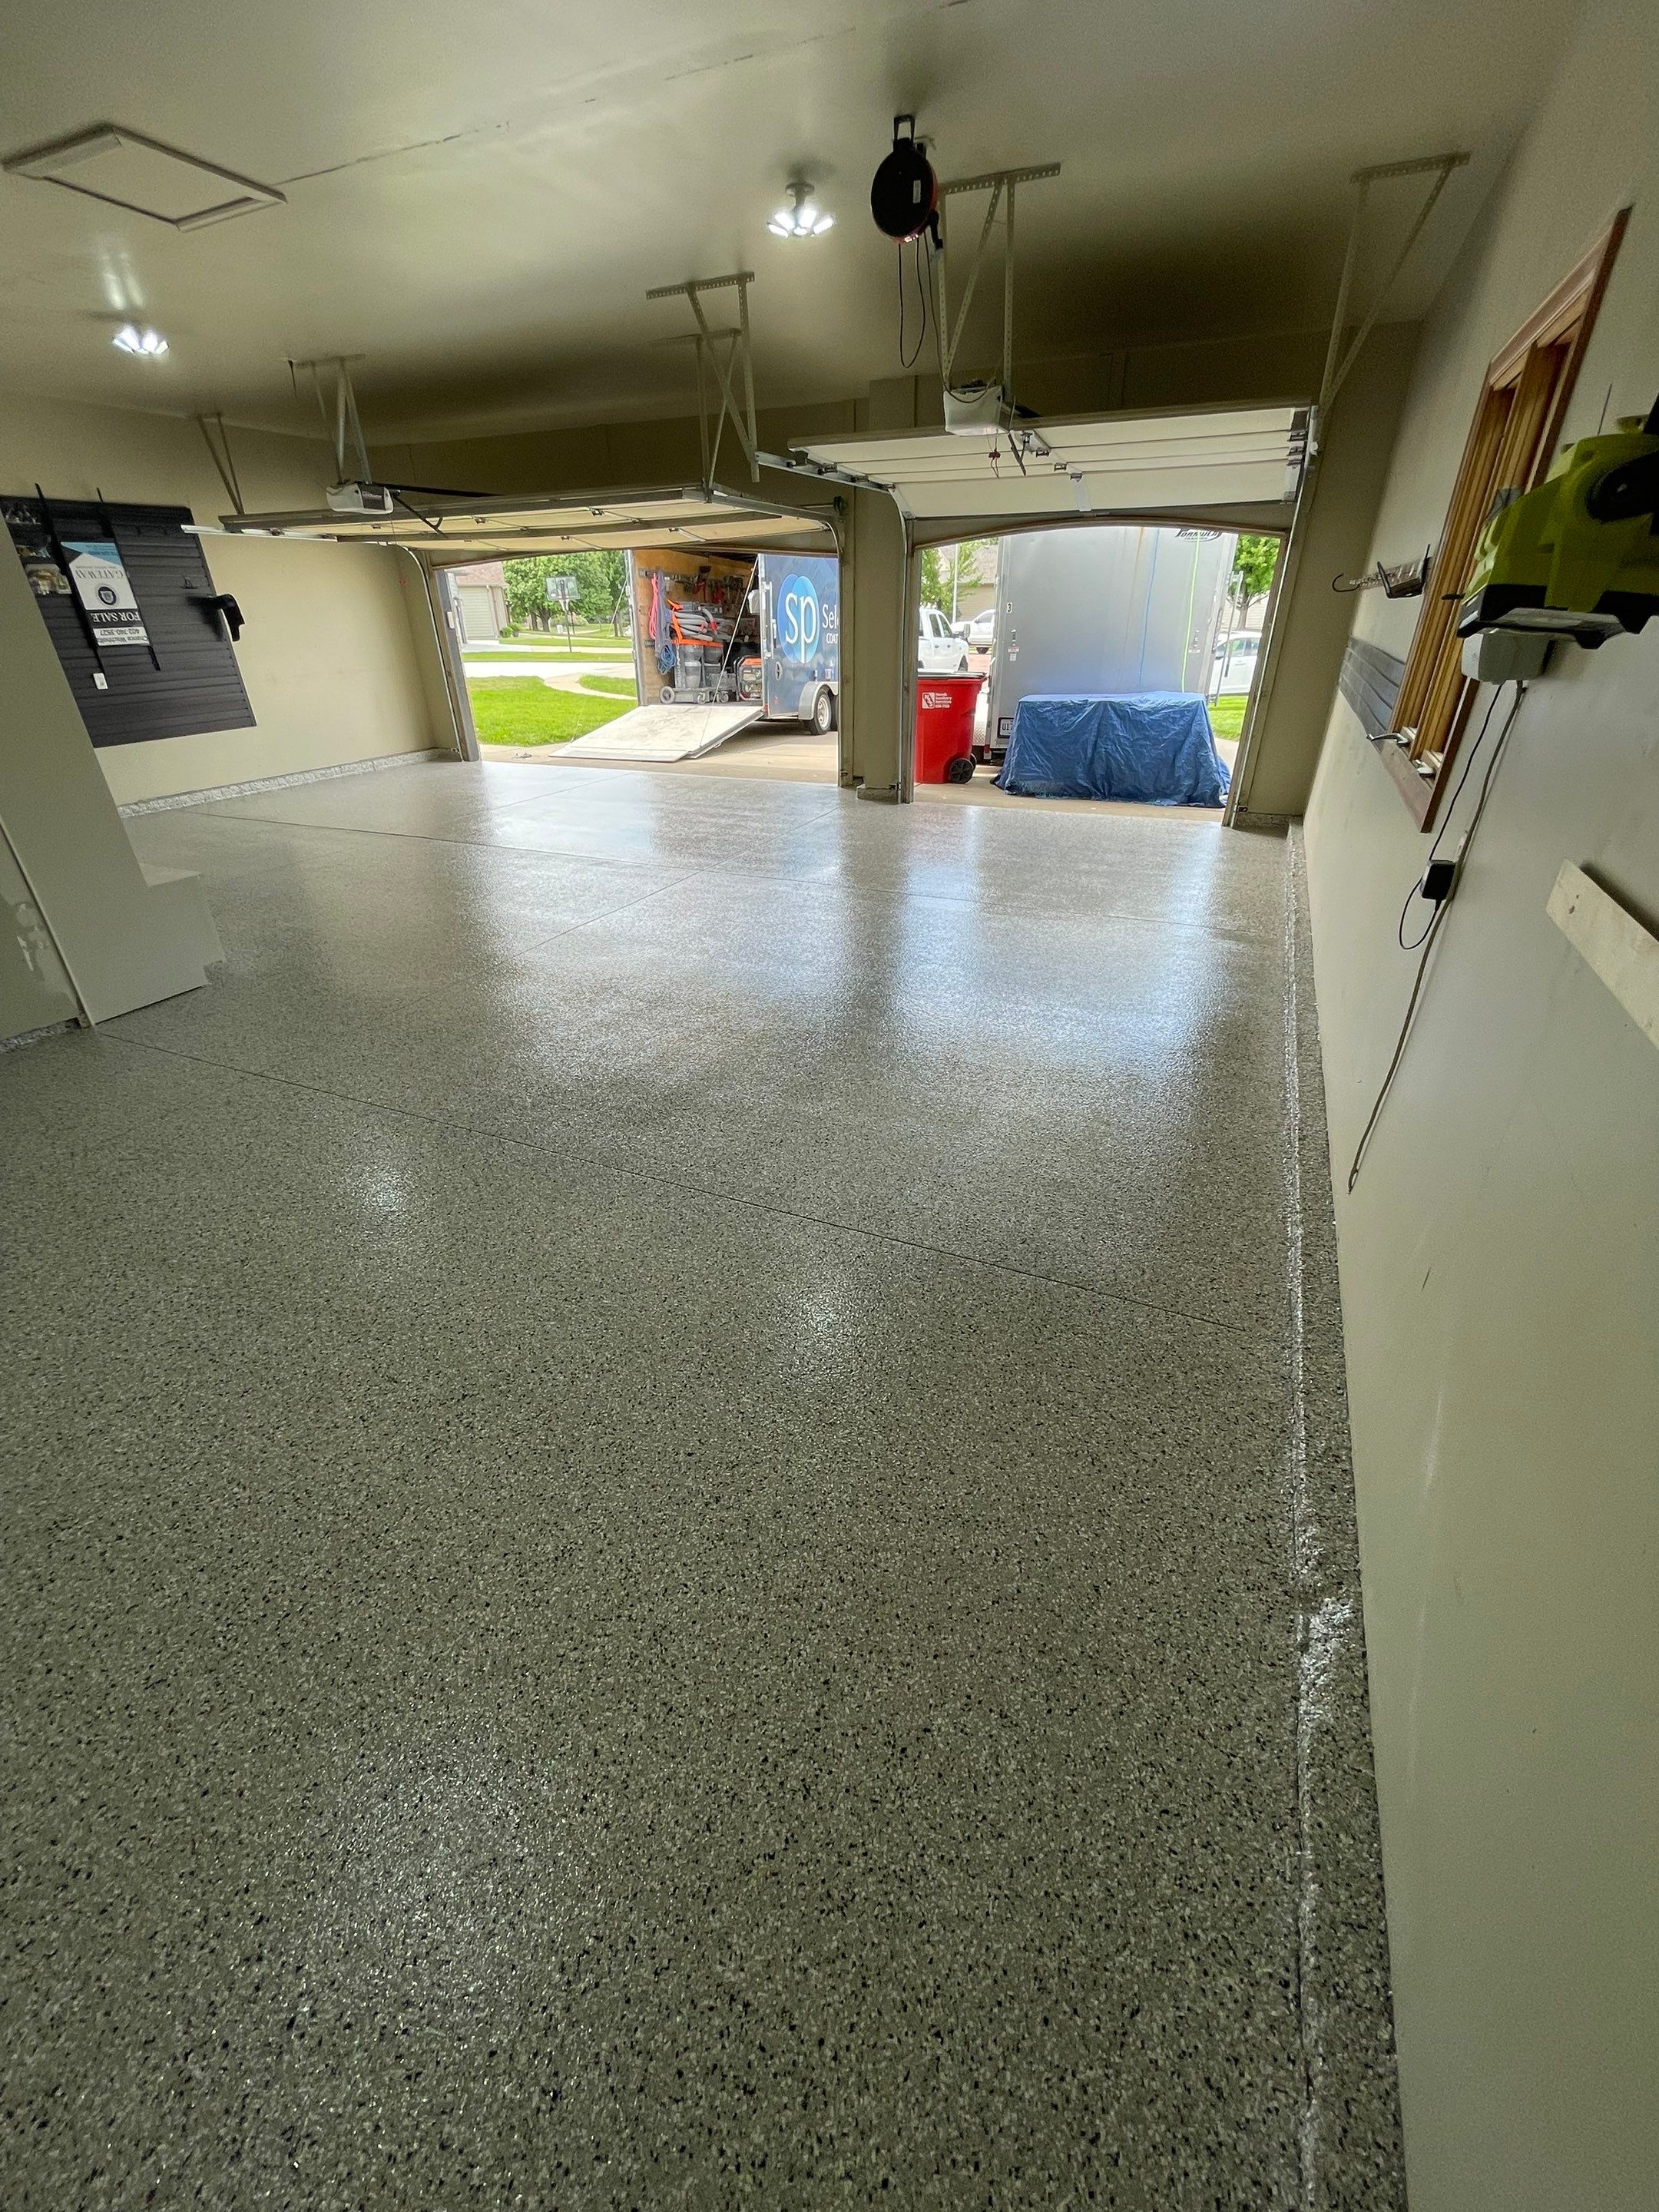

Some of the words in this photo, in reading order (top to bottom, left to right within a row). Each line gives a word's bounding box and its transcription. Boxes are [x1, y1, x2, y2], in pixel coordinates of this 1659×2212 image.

[75, 570, 124, 579] GATEWAY
[1007, 603, 1012, 613] 3
[91, 612, 118, 623] SALE
[121, 611, 141, 621] FOR
